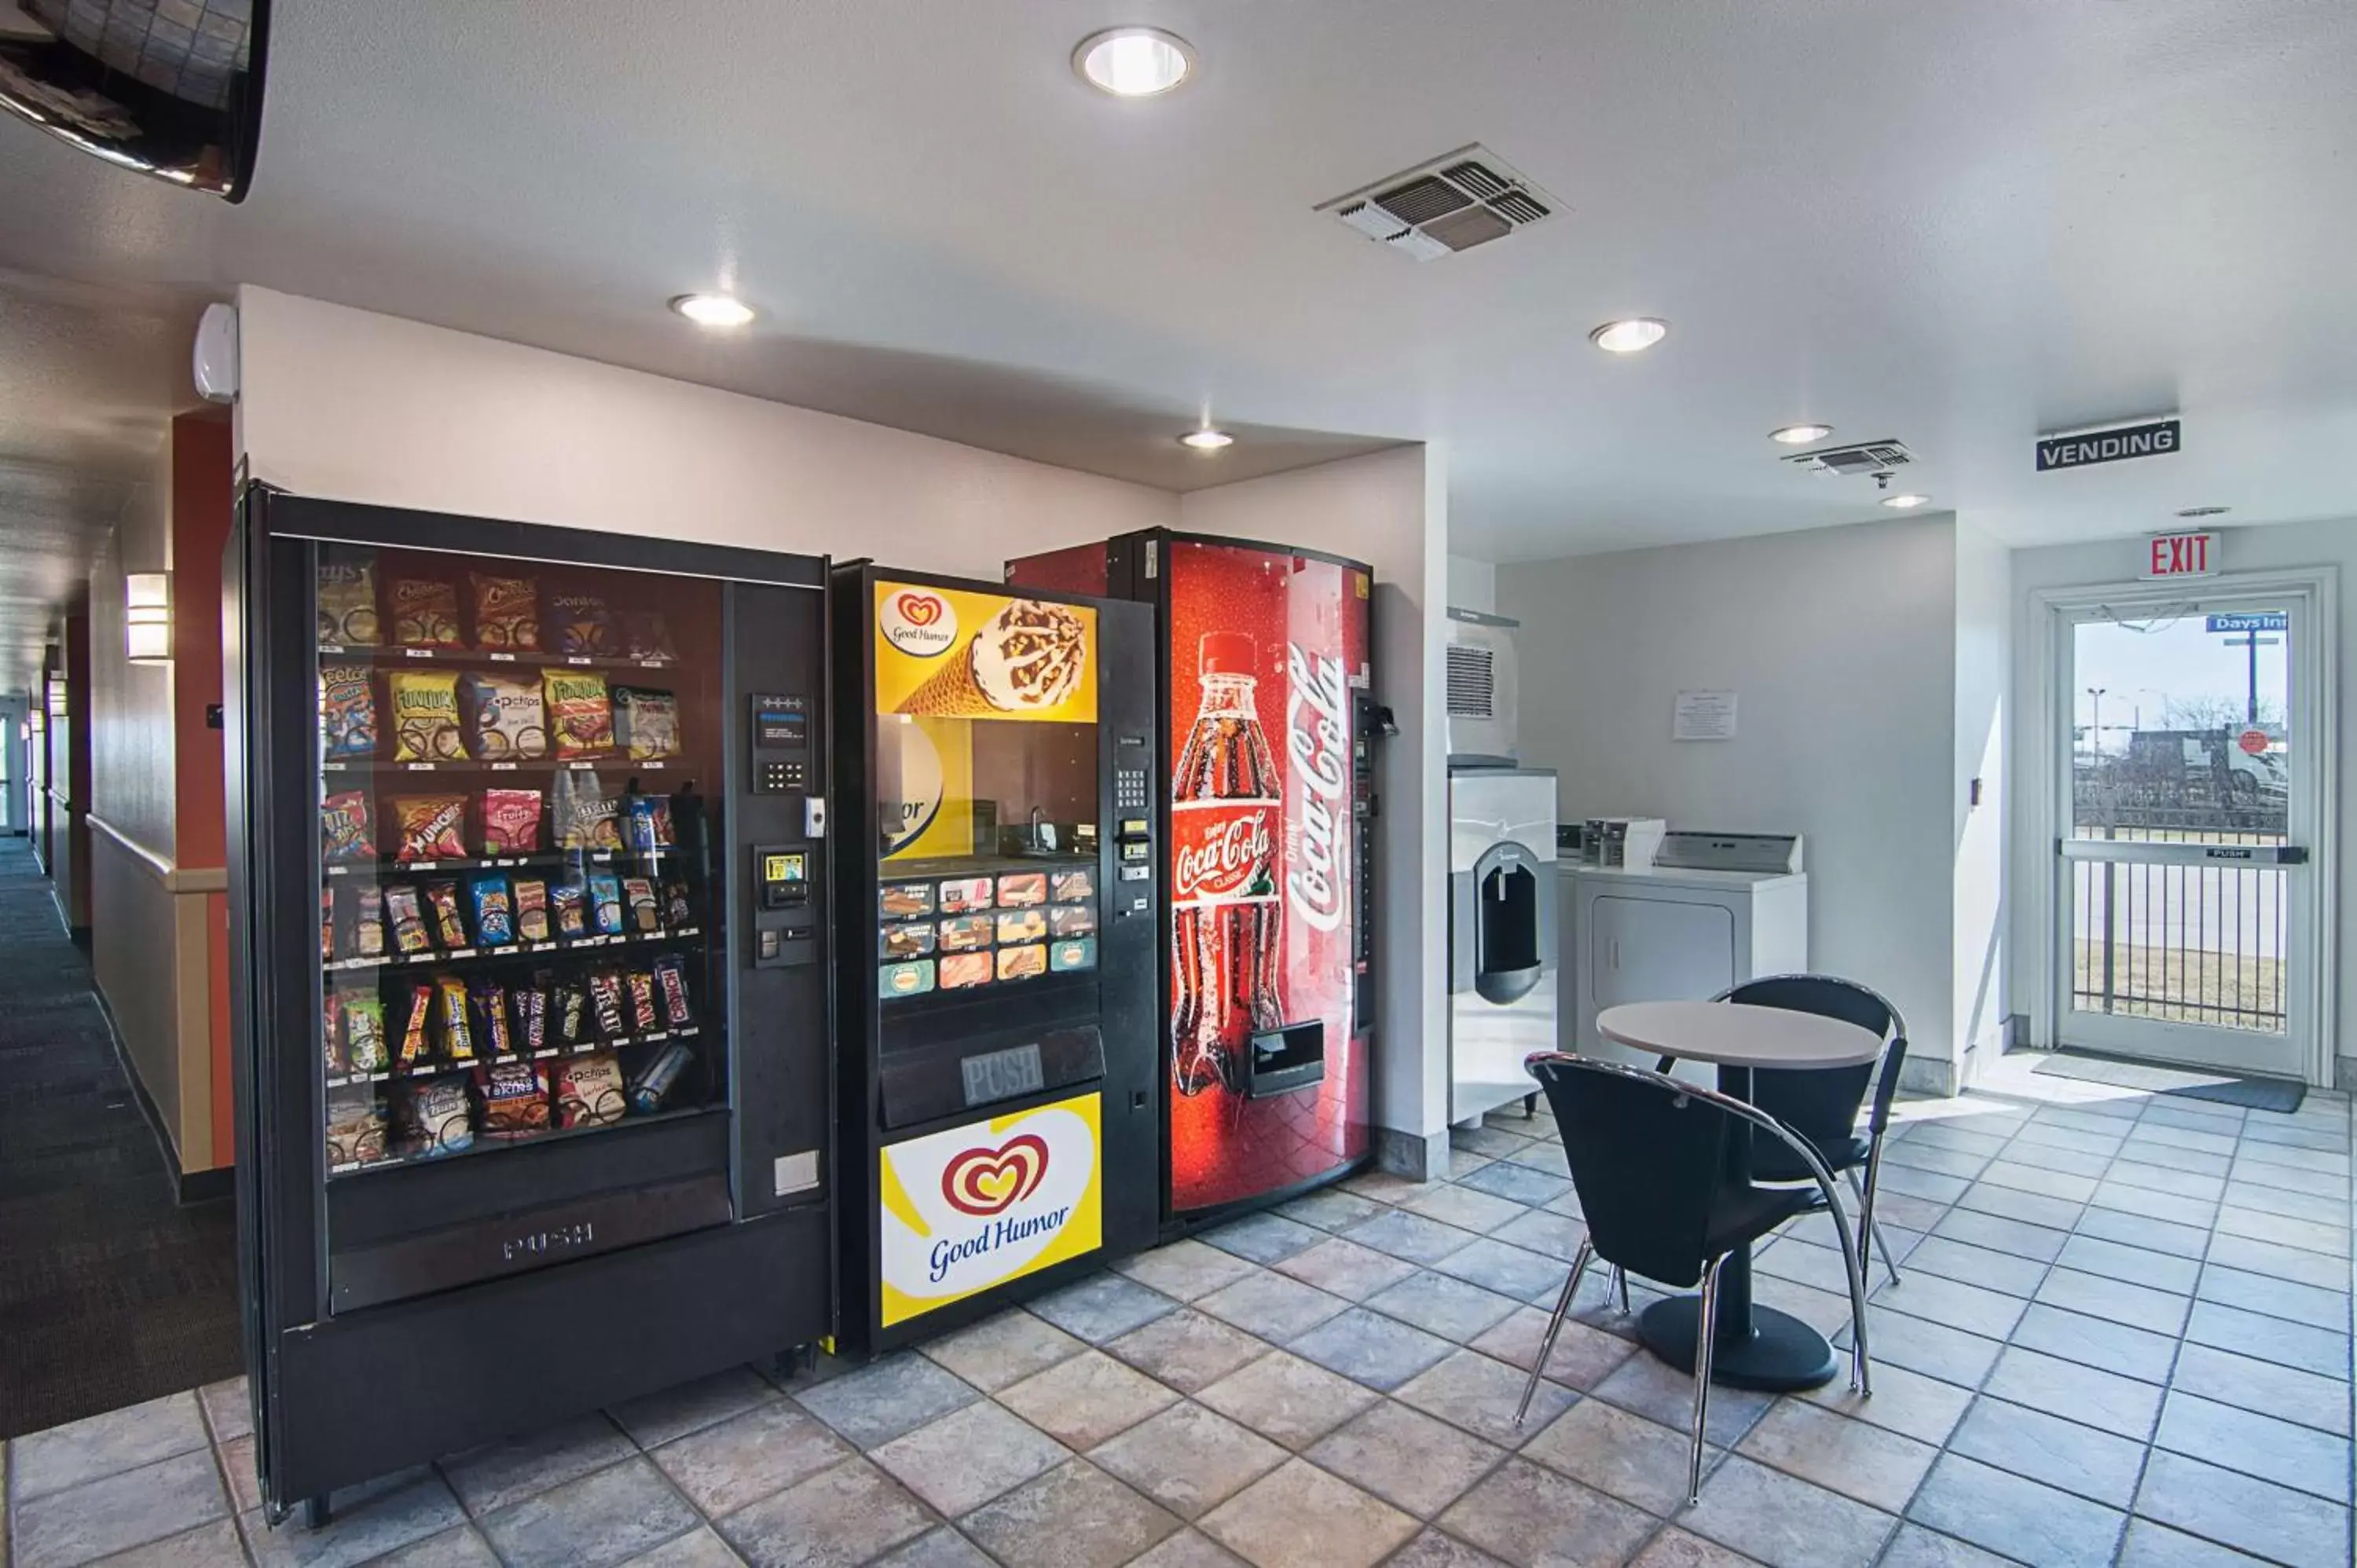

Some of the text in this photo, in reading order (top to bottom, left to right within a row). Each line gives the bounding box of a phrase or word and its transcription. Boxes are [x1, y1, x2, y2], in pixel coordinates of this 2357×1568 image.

[2043, 430, 2173, 467] VENDING
[2151, 534, 2210, 575] EXIT
[893, 626, 949, 643] Good Humor
[2216, 617, 2260, 630] Days
[1287, 640, 1347, 932] Coca-Cola
[1176, 806, 1270, 895] Coca-Cola
[662, 969, 687, 1020] CRUNCH
[568, 1067, 611, 1083] opchips
[967, 1049, 1039, 1101] PUSH
[929, 1206, 1069, 1283] Good Humor
